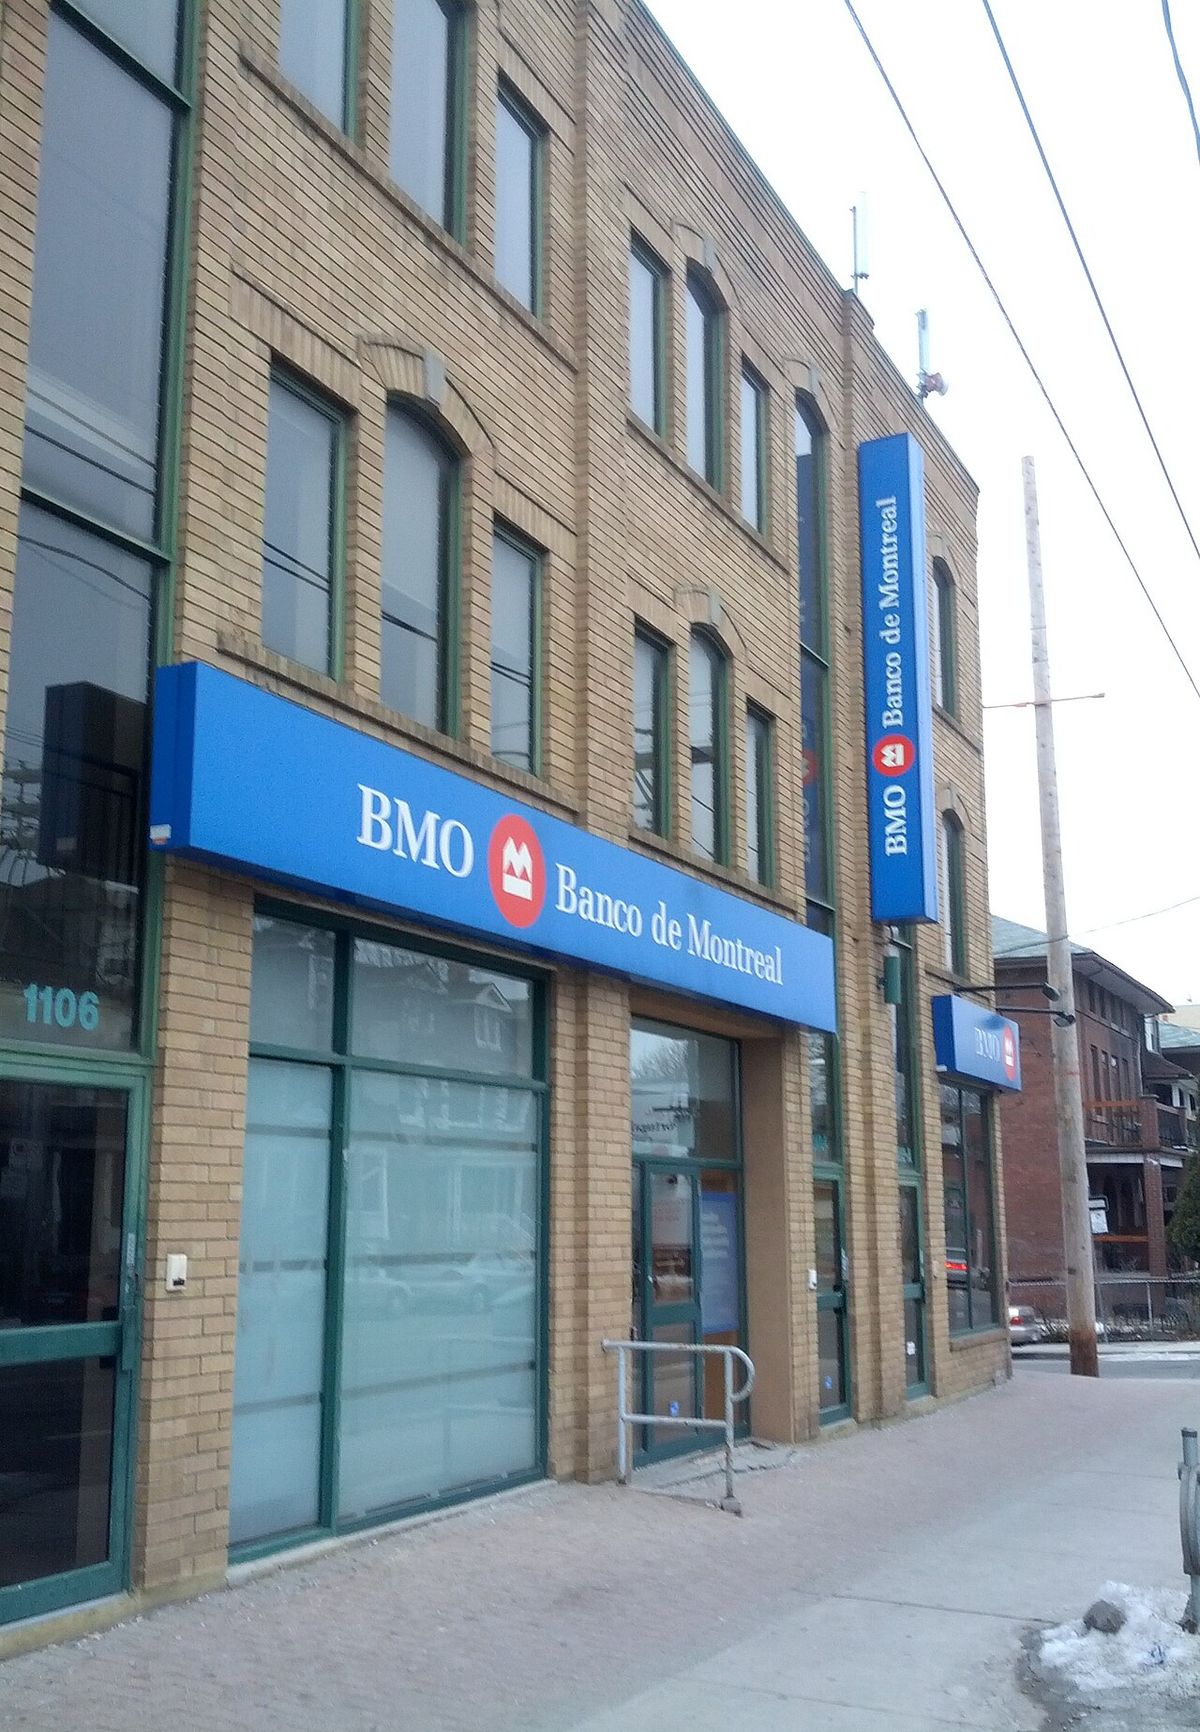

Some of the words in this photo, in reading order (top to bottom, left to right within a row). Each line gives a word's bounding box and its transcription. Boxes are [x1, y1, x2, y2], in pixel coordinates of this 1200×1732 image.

[875, 495, 899, 609] Montreal
[879, 613, 900, 645] de
[881, 651, 904, 729] Banco
[884, 784, 908, 856] BMO
[356, 783, 475, 879] BMO
[555, 862, 643, 938] Banco
[651, 901, 682, 952] de
[686, 912, 784, 986] Montreal
[23, 983, 100, 1032] 1106
[974, 1025, 1001, 1063] BMO
